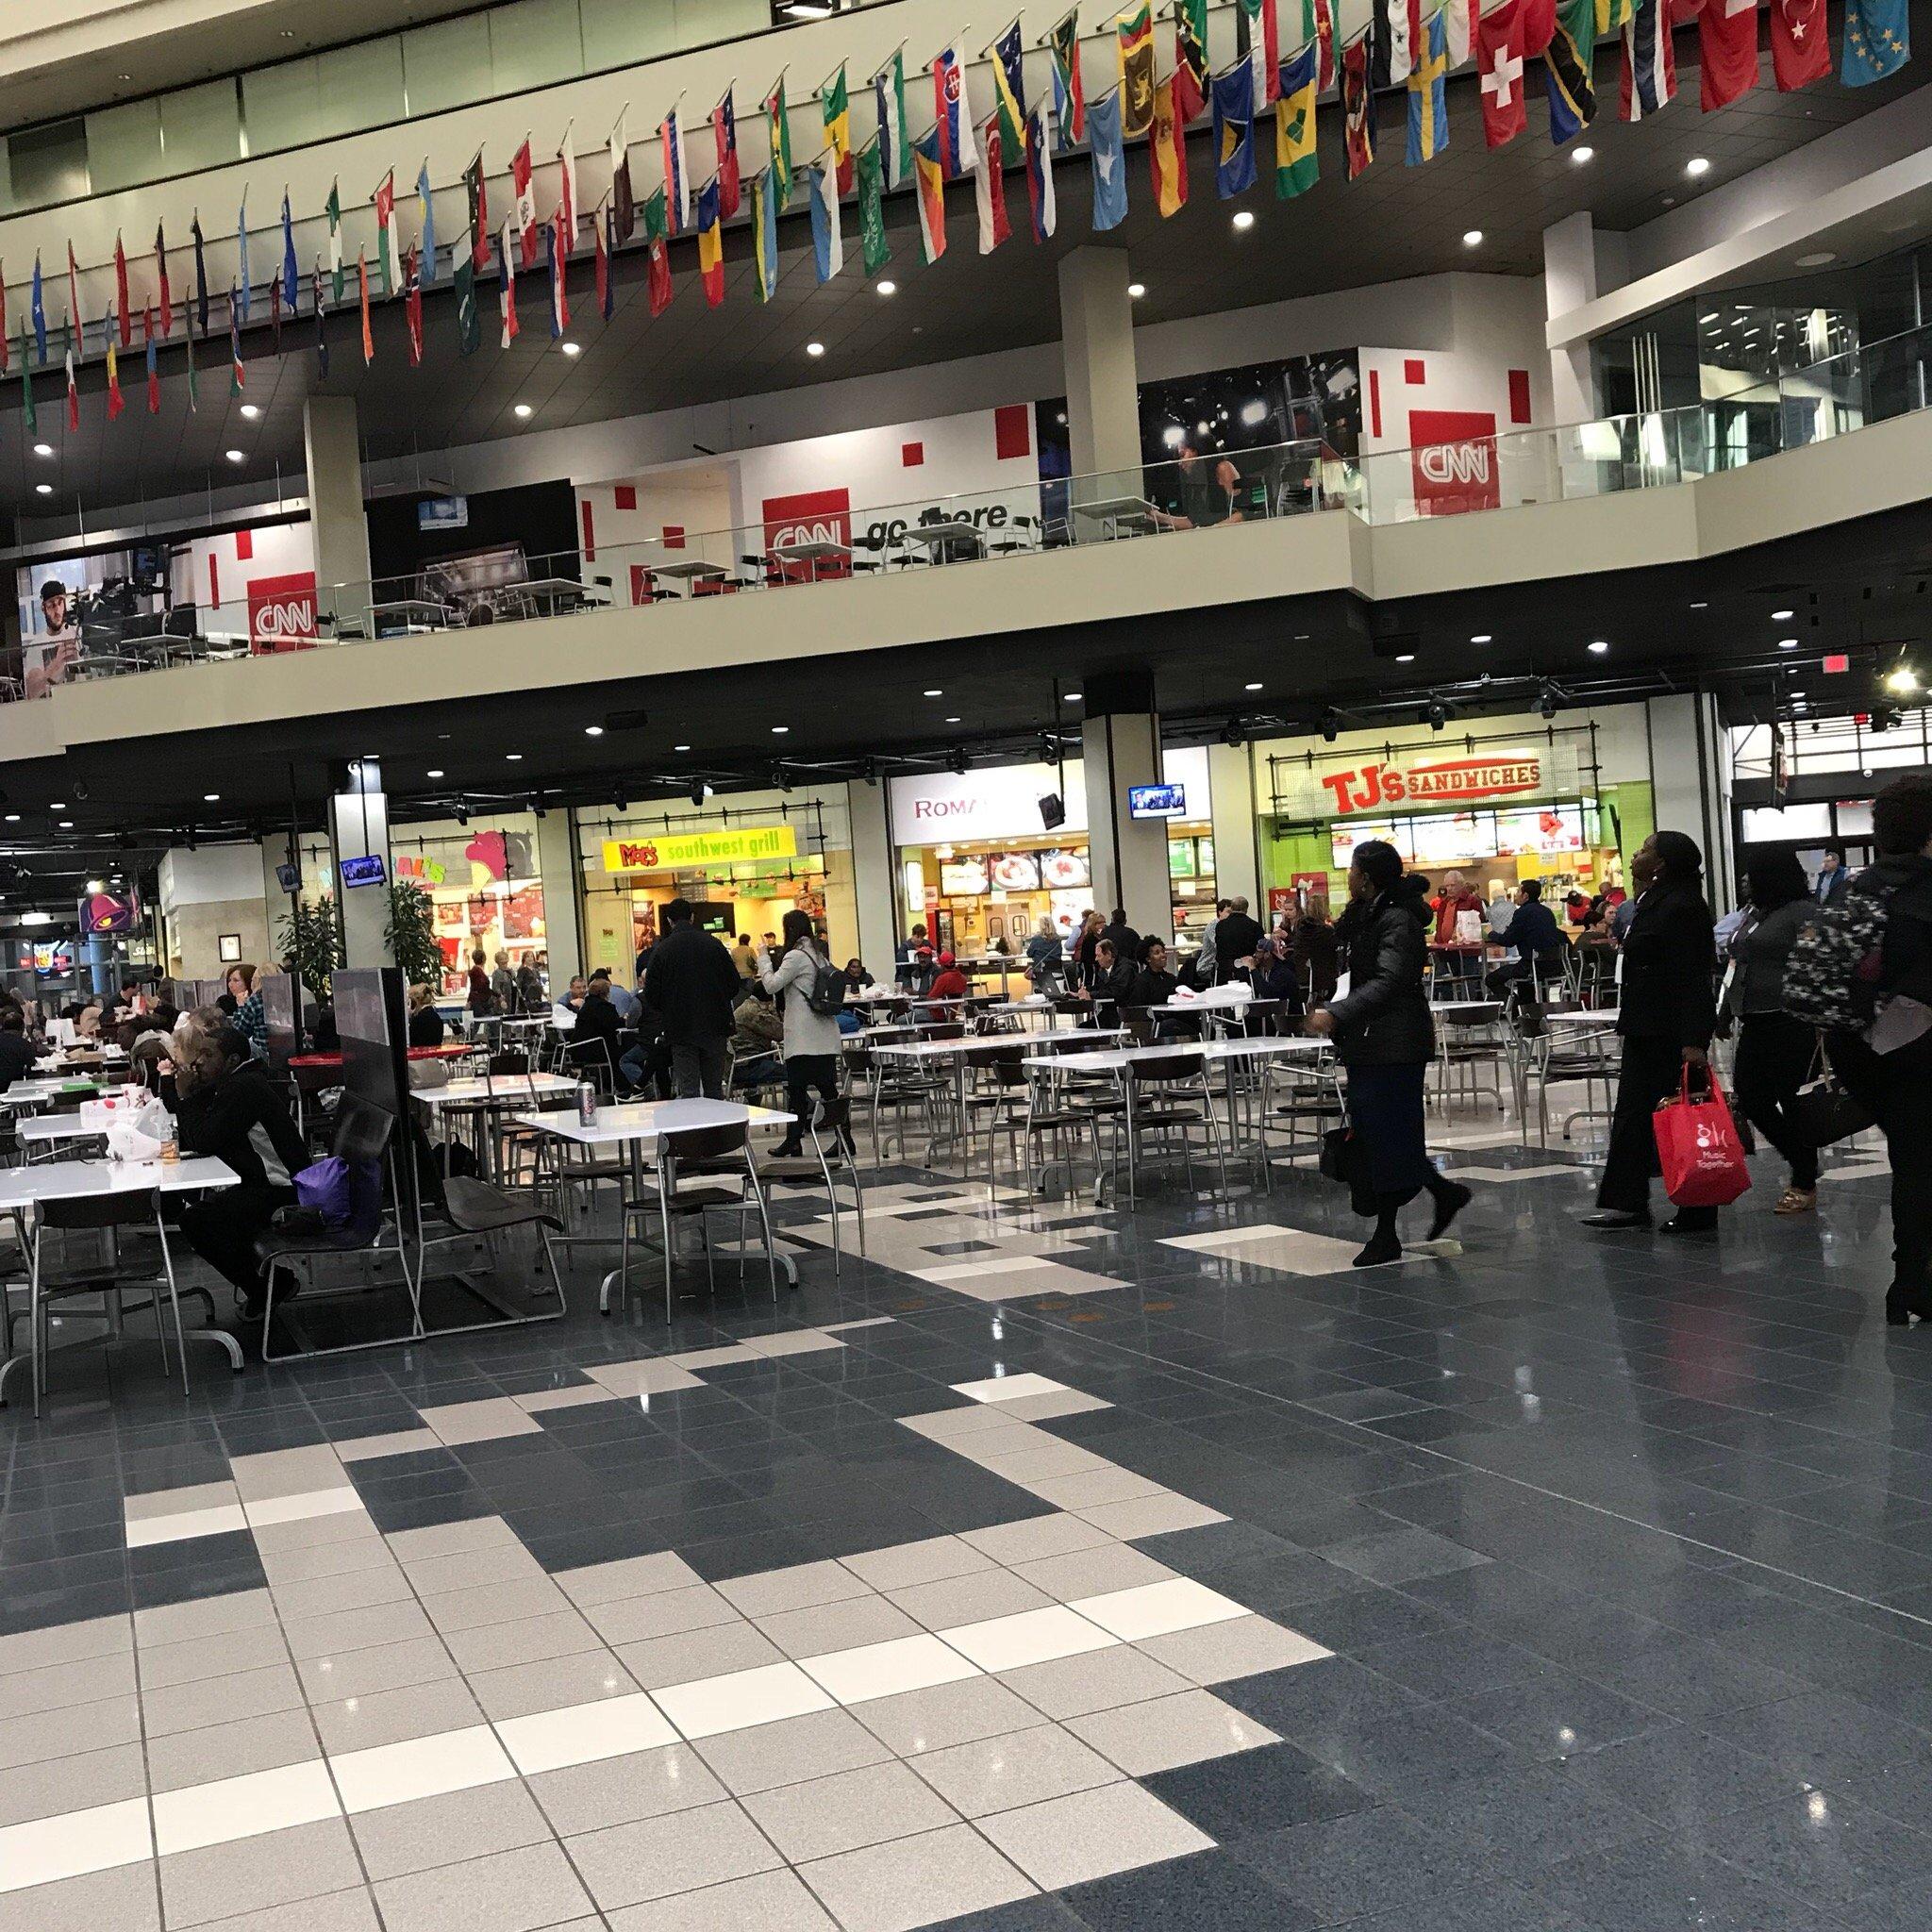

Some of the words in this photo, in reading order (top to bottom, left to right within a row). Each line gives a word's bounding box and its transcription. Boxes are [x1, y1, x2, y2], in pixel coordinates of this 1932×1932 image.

[1420, 444, 1490, 484] CNN
[867, 519, 908, 552] go
[256, 599, 312, 637] CNN
[1322, 762, 1406, 814] TJ's
[1407, 763, 1541, 793] SANDWICHES
[668, 836, 744, 859] southwest
[749, 830, 780, 858] grill
